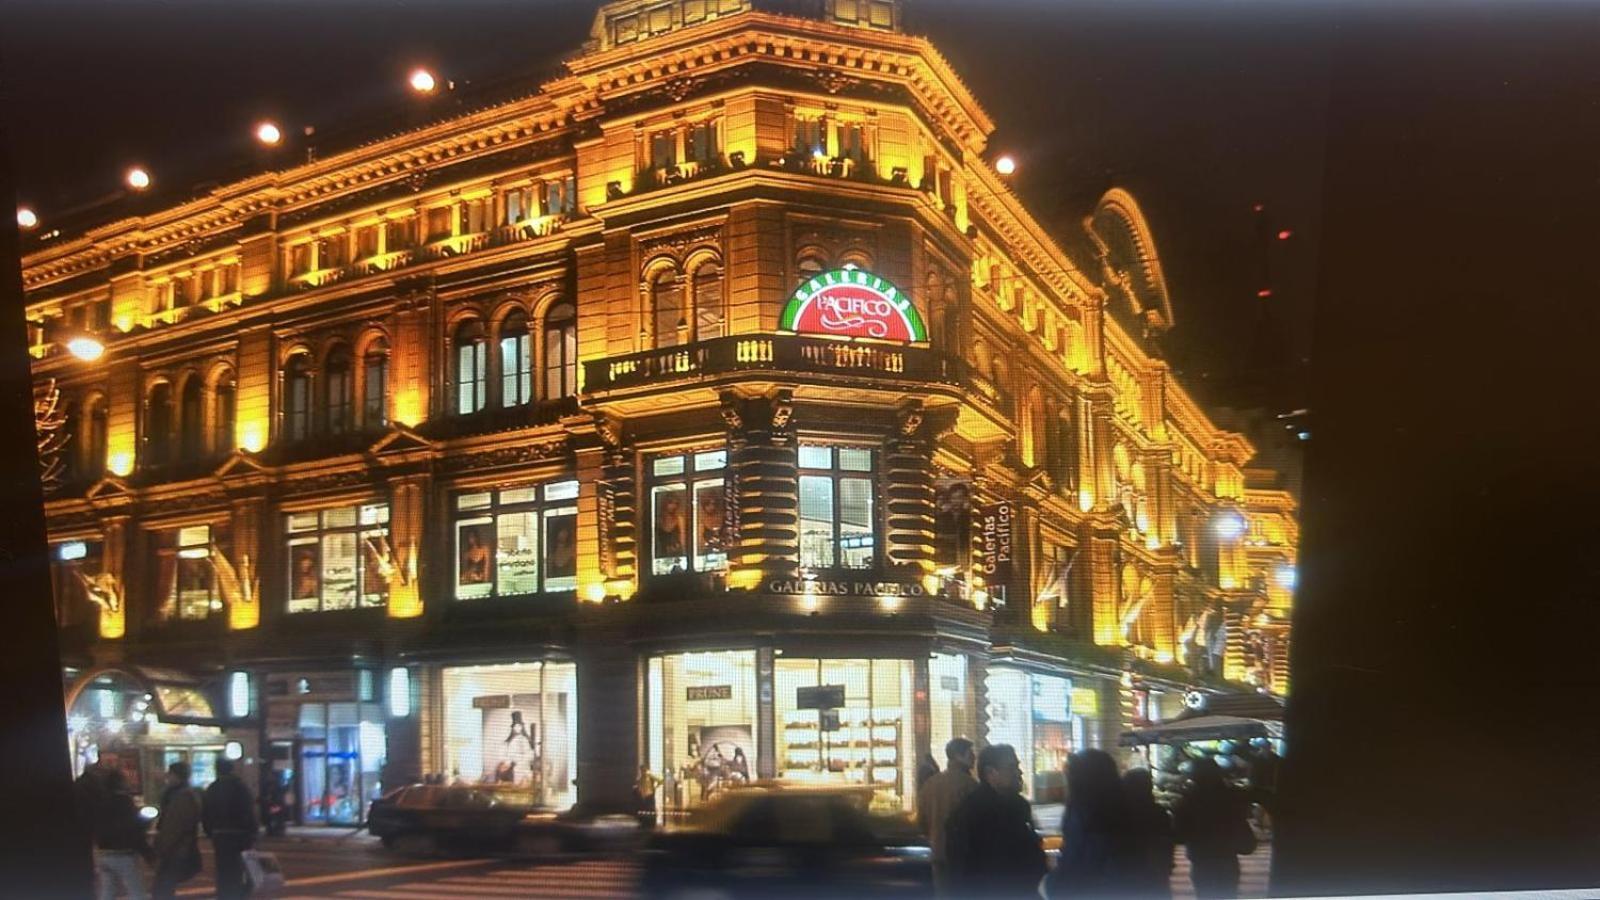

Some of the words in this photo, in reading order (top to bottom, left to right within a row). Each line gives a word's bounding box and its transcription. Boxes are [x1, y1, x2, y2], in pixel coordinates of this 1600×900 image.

[795, 271, 910, 310] GALERIAS
[816, 294, 892, 320] PACIFICO
[769, 580, 848, 595] GALERIAS
[853, 581, 923, 596] PACIFICO
